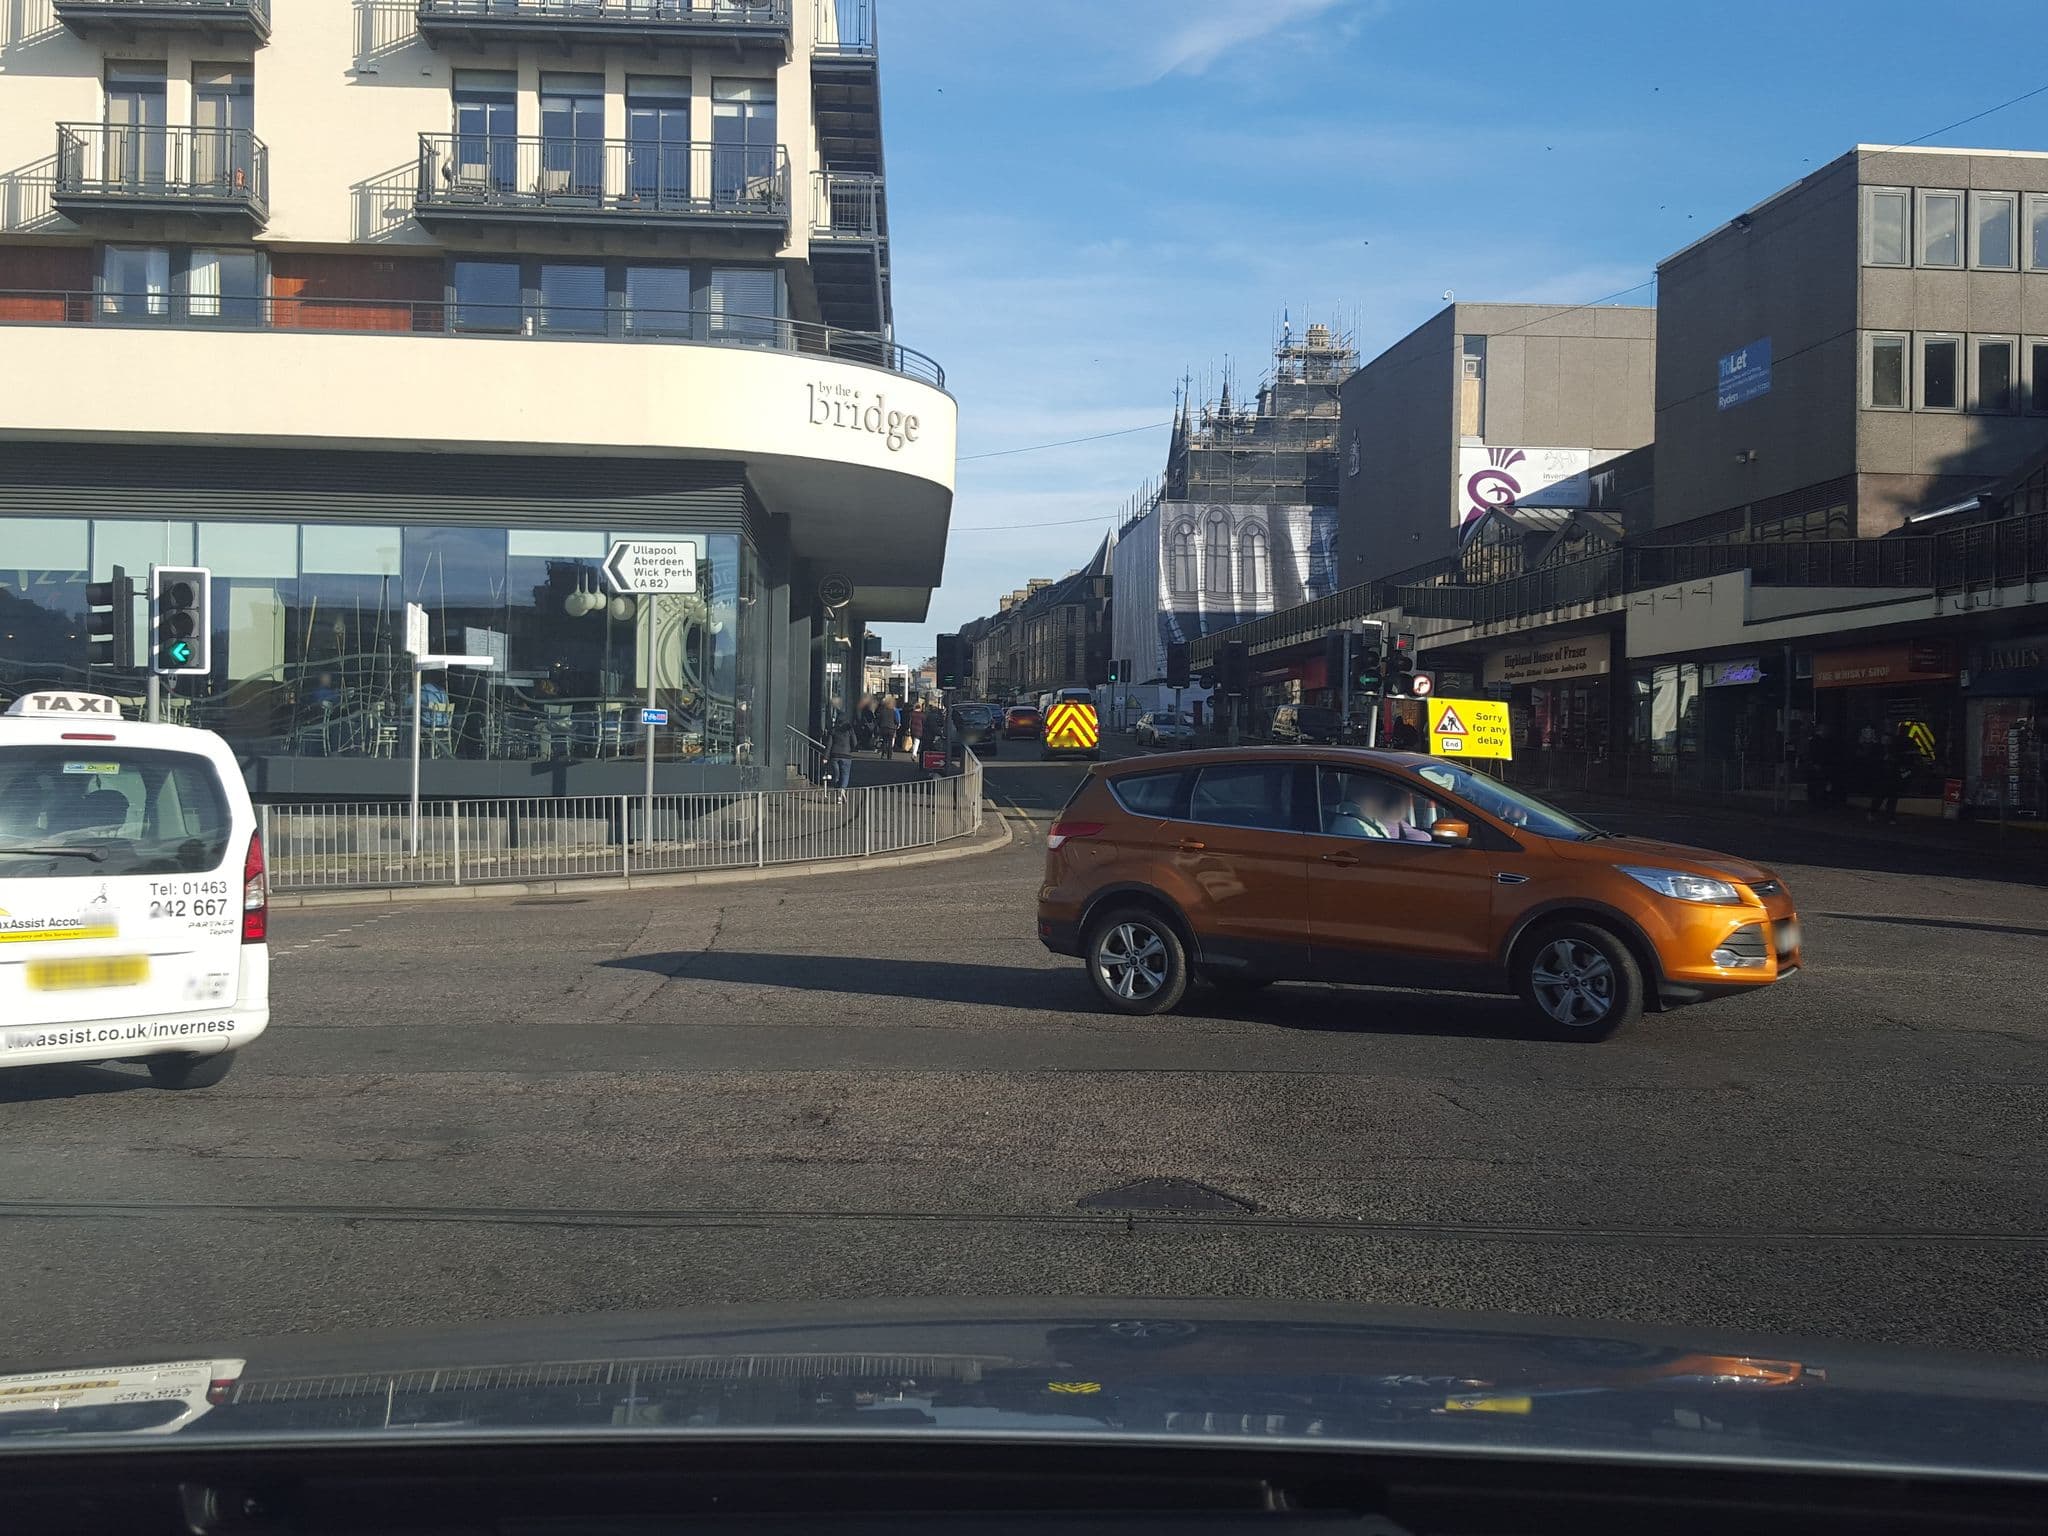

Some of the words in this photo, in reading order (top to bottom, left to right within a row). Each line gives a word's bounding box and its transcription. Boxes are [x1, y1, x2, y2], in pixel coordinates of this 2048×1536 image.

[818, 381, 833, 396] by
[835, 384, 851, 397] the
[806, 383, 920, 451] bridge
[632, 545, 677, 556] Ullapool
[634, 556, 684, 566] Aberdeen
[634, 567, 660, 577] Wick
[664, 568, 693, 577] Perth
[1554, 647, 1562, 660] of
[1564, 645, 1587, 659] Fraser
[32, 694, 113, 713] TAXI
[1475, 712, 1503, 724] Sorry
[1472, 723, 1487, 734] for
[1490, 725, 1507, 736] any
[1444, 740, 1459, 748] End
[1477, 735, 1504, 747] delay
[149, 883, 177, 896] Tel:
[182, 881, 228, 895] 01463
[150, 900, 186, 918] 242
[193, 898, 228, 917] 667
